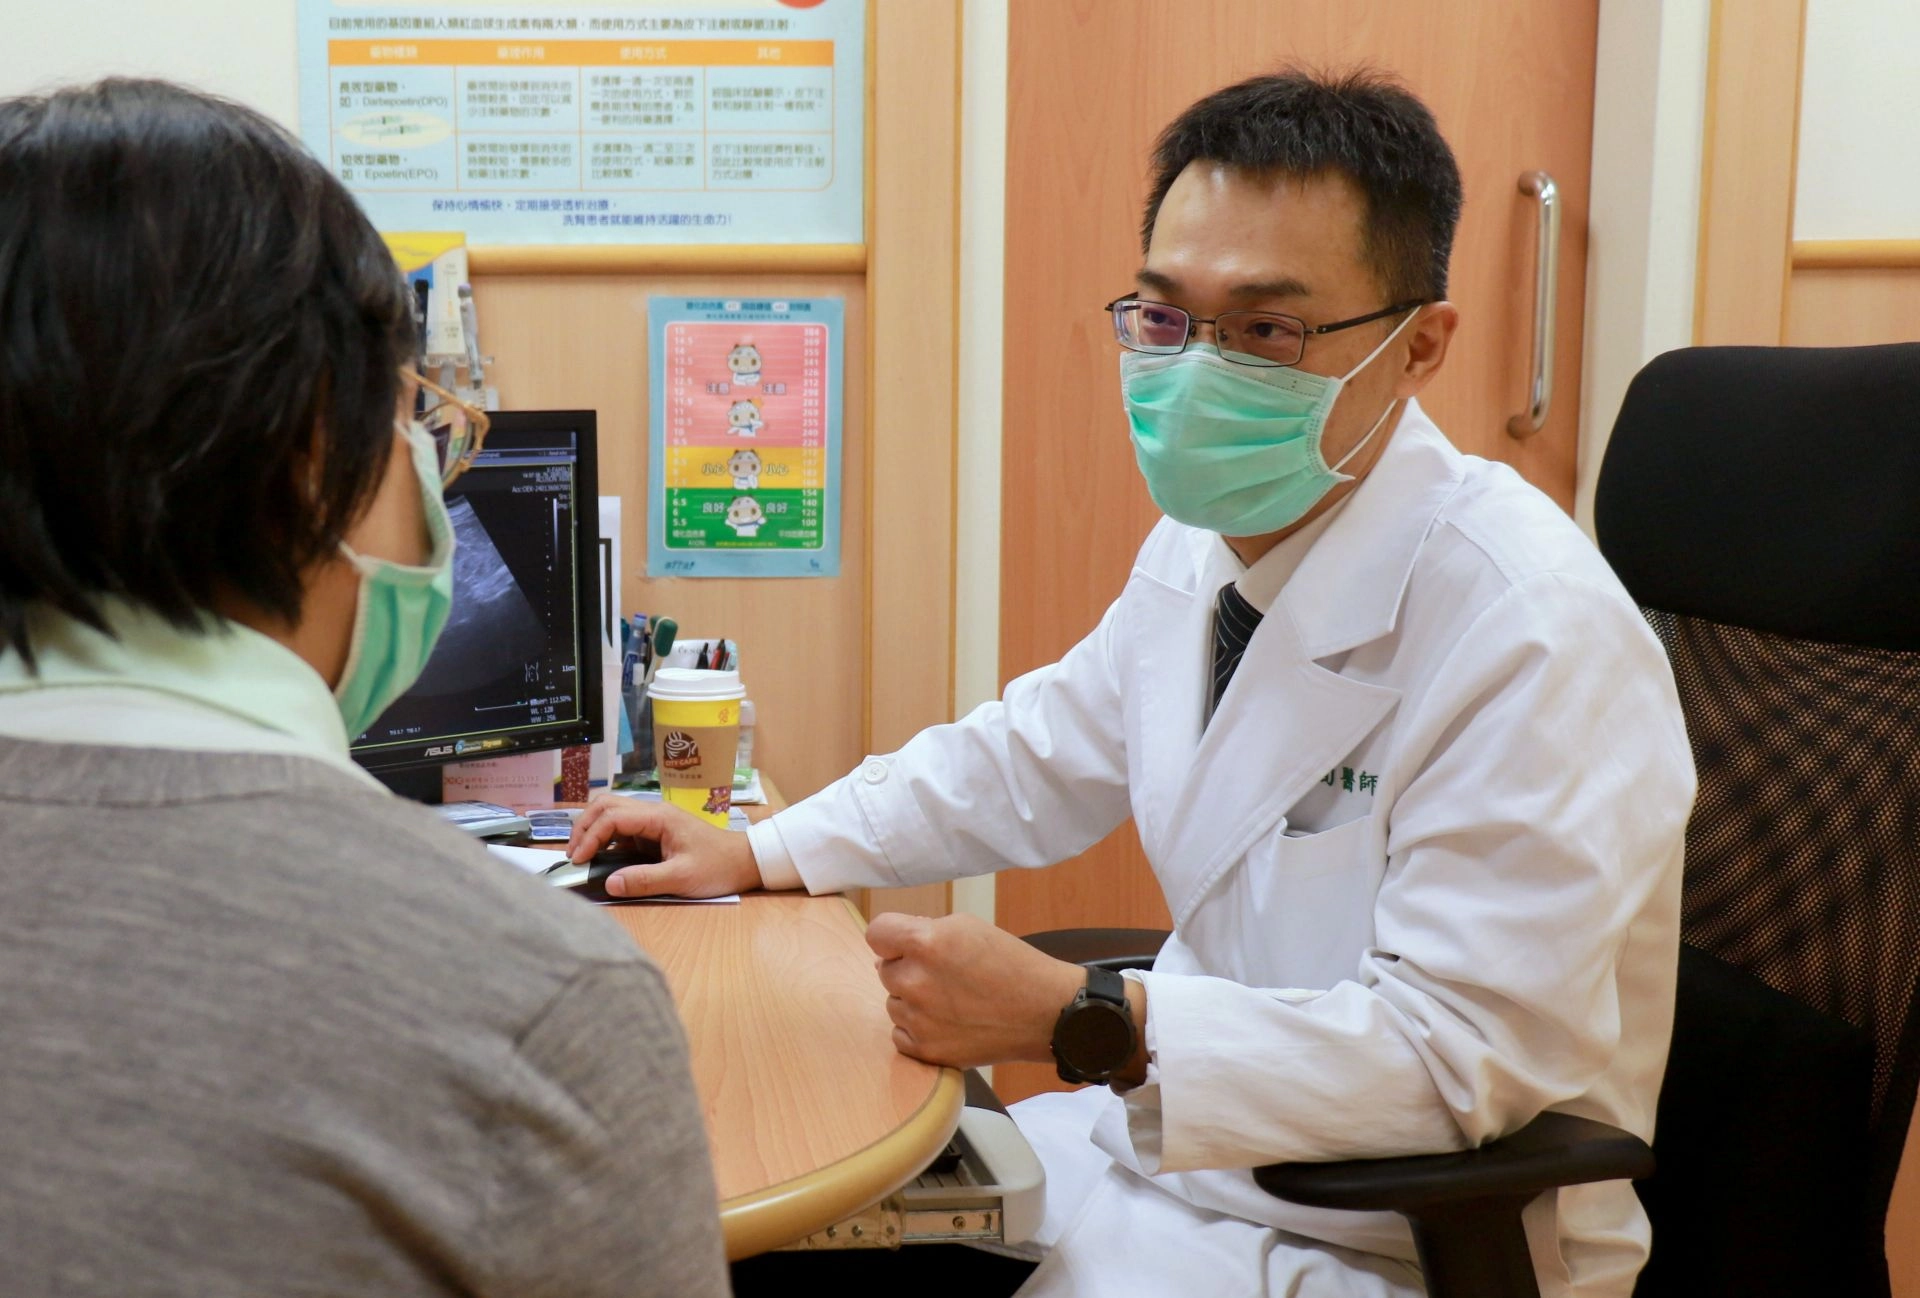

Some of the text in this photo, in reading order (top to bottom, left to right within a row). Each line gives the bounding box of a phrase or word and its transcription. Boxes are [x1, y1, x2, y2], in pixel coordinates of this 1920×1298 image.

[673, 488, 679, 496] 7
[802, 489, 817, 497] 154
[672, 498, 688, 507] 6.5
[802, 499, 817, 507] 140
[672, 508, 679, 516] 6
[702, 502, 725, 514] 良好
[765, 502, 788, 514] 良好
[802, 509, 817, 517] 126
[672, 518, 688, 527] 5.5
[801, 519, 817, 527] 100
[424, 745, 453, 758] ASUS
